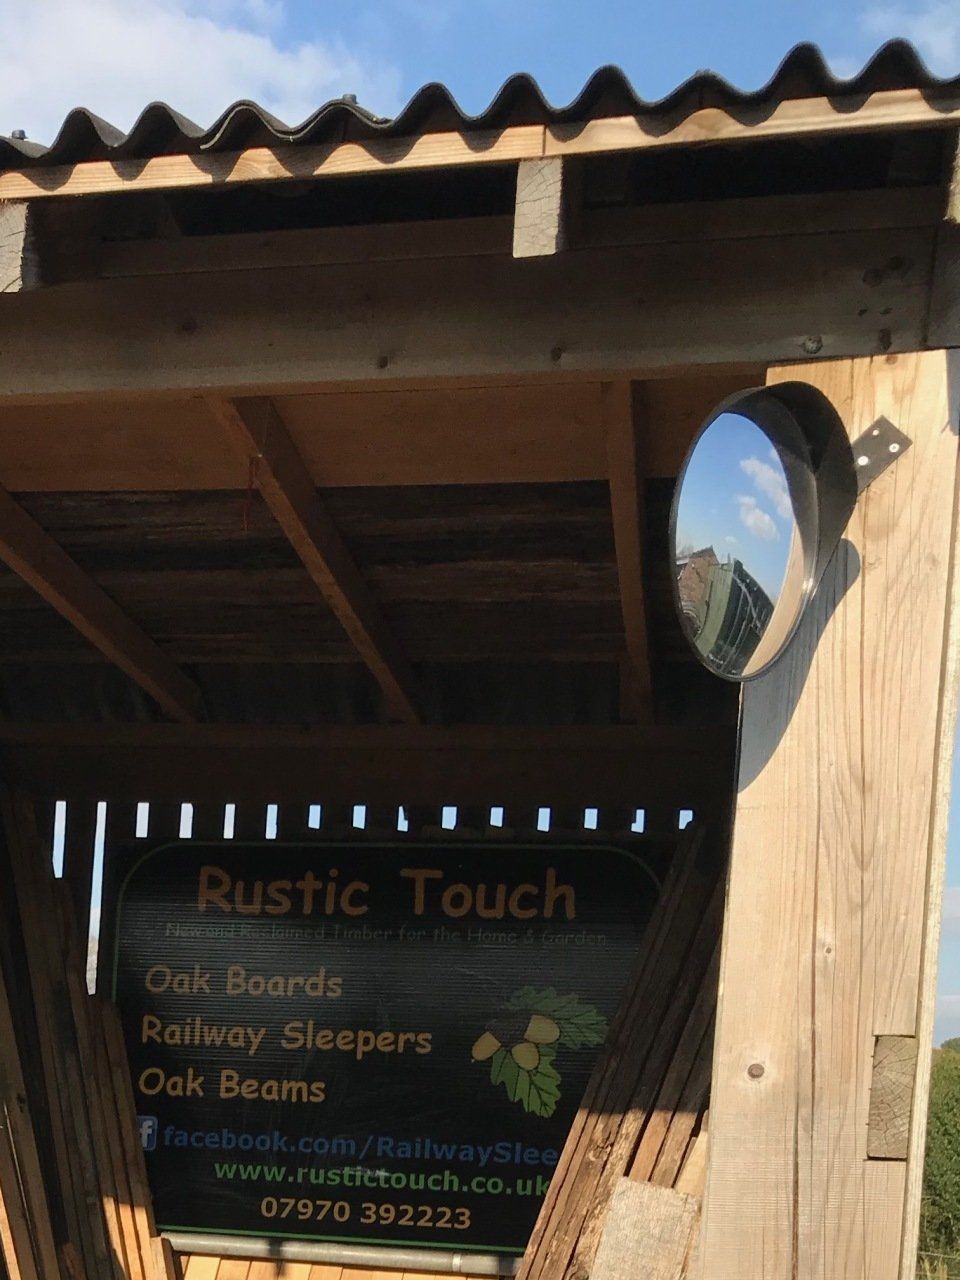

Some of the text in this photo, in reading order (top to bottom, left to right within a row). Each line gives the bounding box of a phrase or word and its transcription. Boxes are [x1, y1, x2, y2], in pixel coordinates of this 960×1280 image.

[196, 864, 577, 920] Rustic Touch
[335, 924, 390, 943] Timber
[399, 924, 426, 944] for
[432, 926, 461, 942] the
[467, 927, 518, 944] Home
[542, 931, 607, 945] Garden
[145, 964, 343, 998] Oak Boards
[141, 1013, 433, 1061] Railway Sleepers
[139, 1066, 327, 1103] Oak Beams
[213, 1161, 550, 1197] www.rustictouch.co.uk
[260, 1196, 472, 1230] 07970 392223
